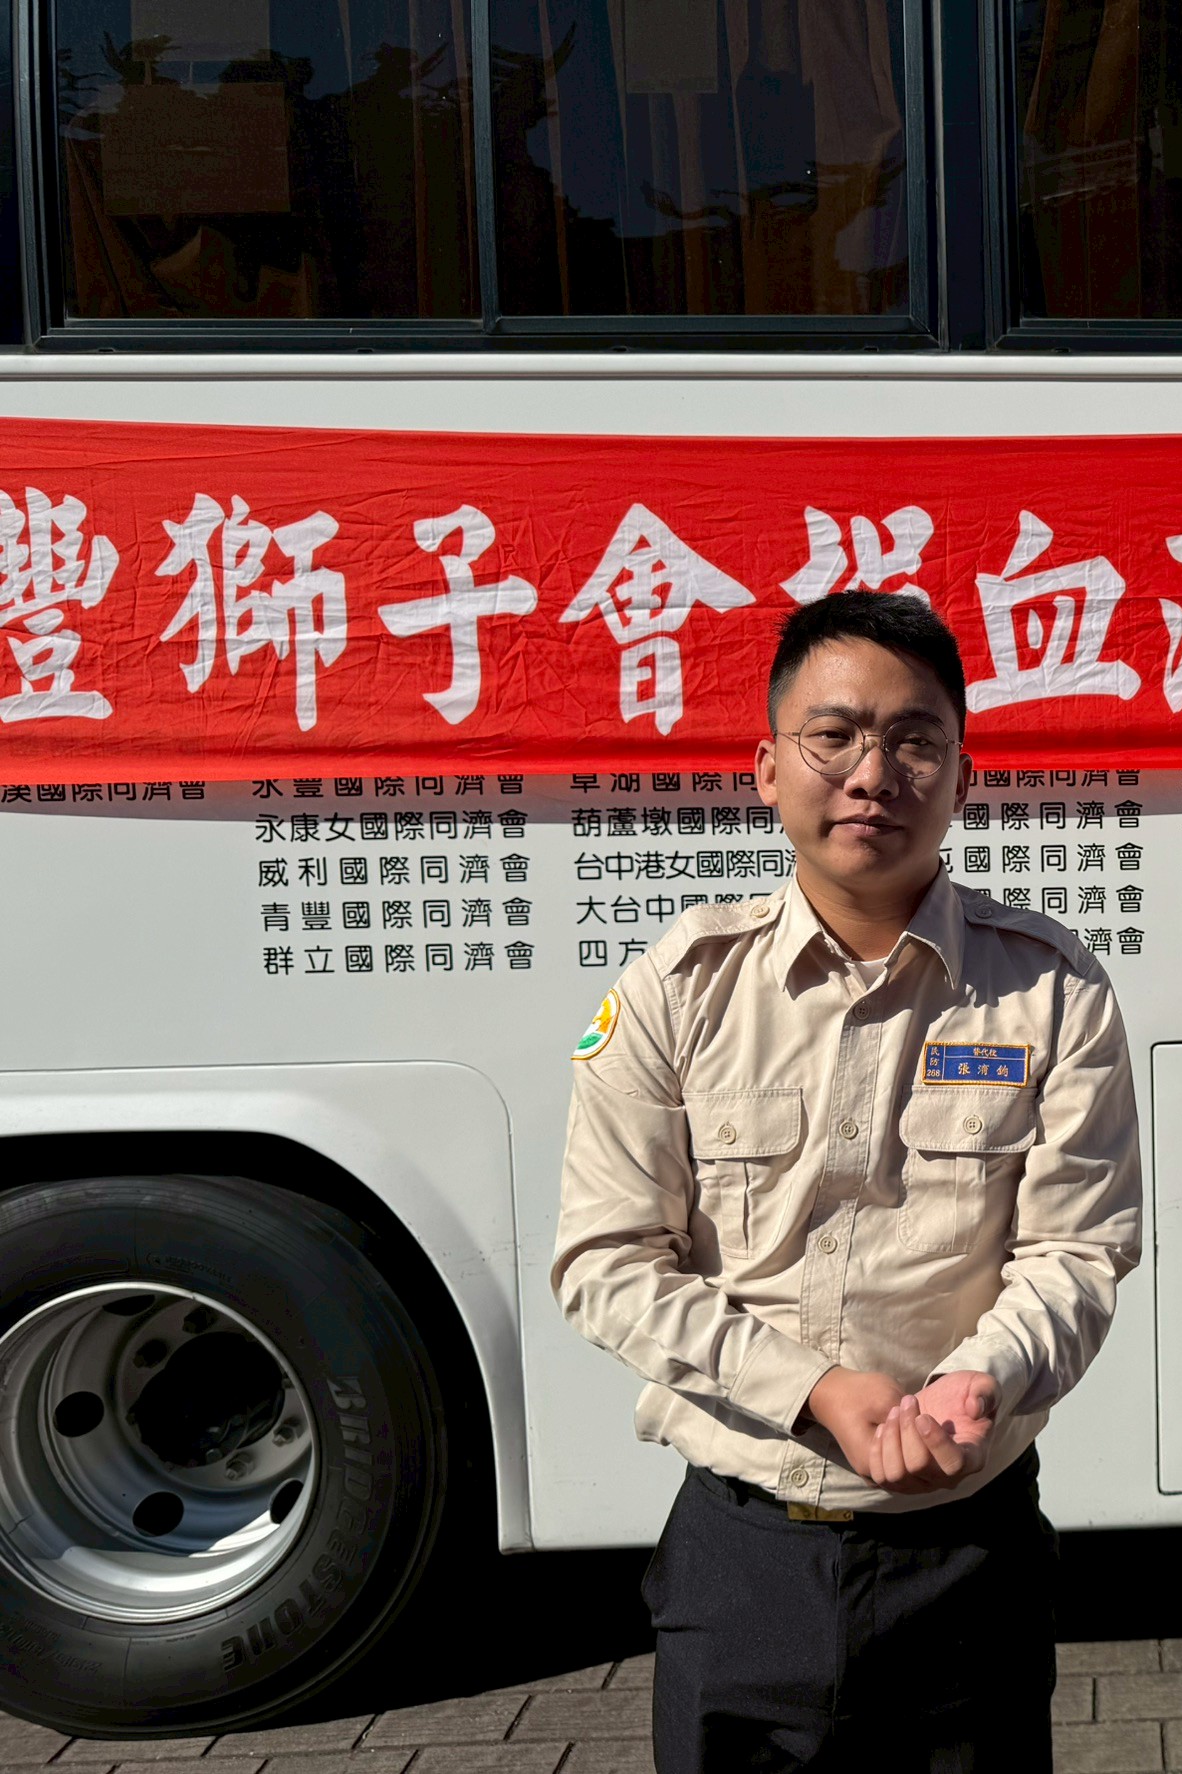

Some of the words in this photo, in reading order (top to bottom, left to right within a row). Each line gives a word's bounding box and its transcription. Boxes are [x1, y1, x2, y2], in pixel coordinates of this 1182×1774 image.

[255, 809, 529, 842] 永康女國際同濟會
[571, 805, 784, 837] 葫蘆墩國際同
[950, 799, 1144, 830] 國際同濟會
[258, 853, 530, 887] 威利國際同濟會
[261, 897, 532, 932] 青豐國際同濟會
[263, 940, 535, 975] 群立國際同濟會
[220, 1375, 376, 1672] BRIDGESTONE
